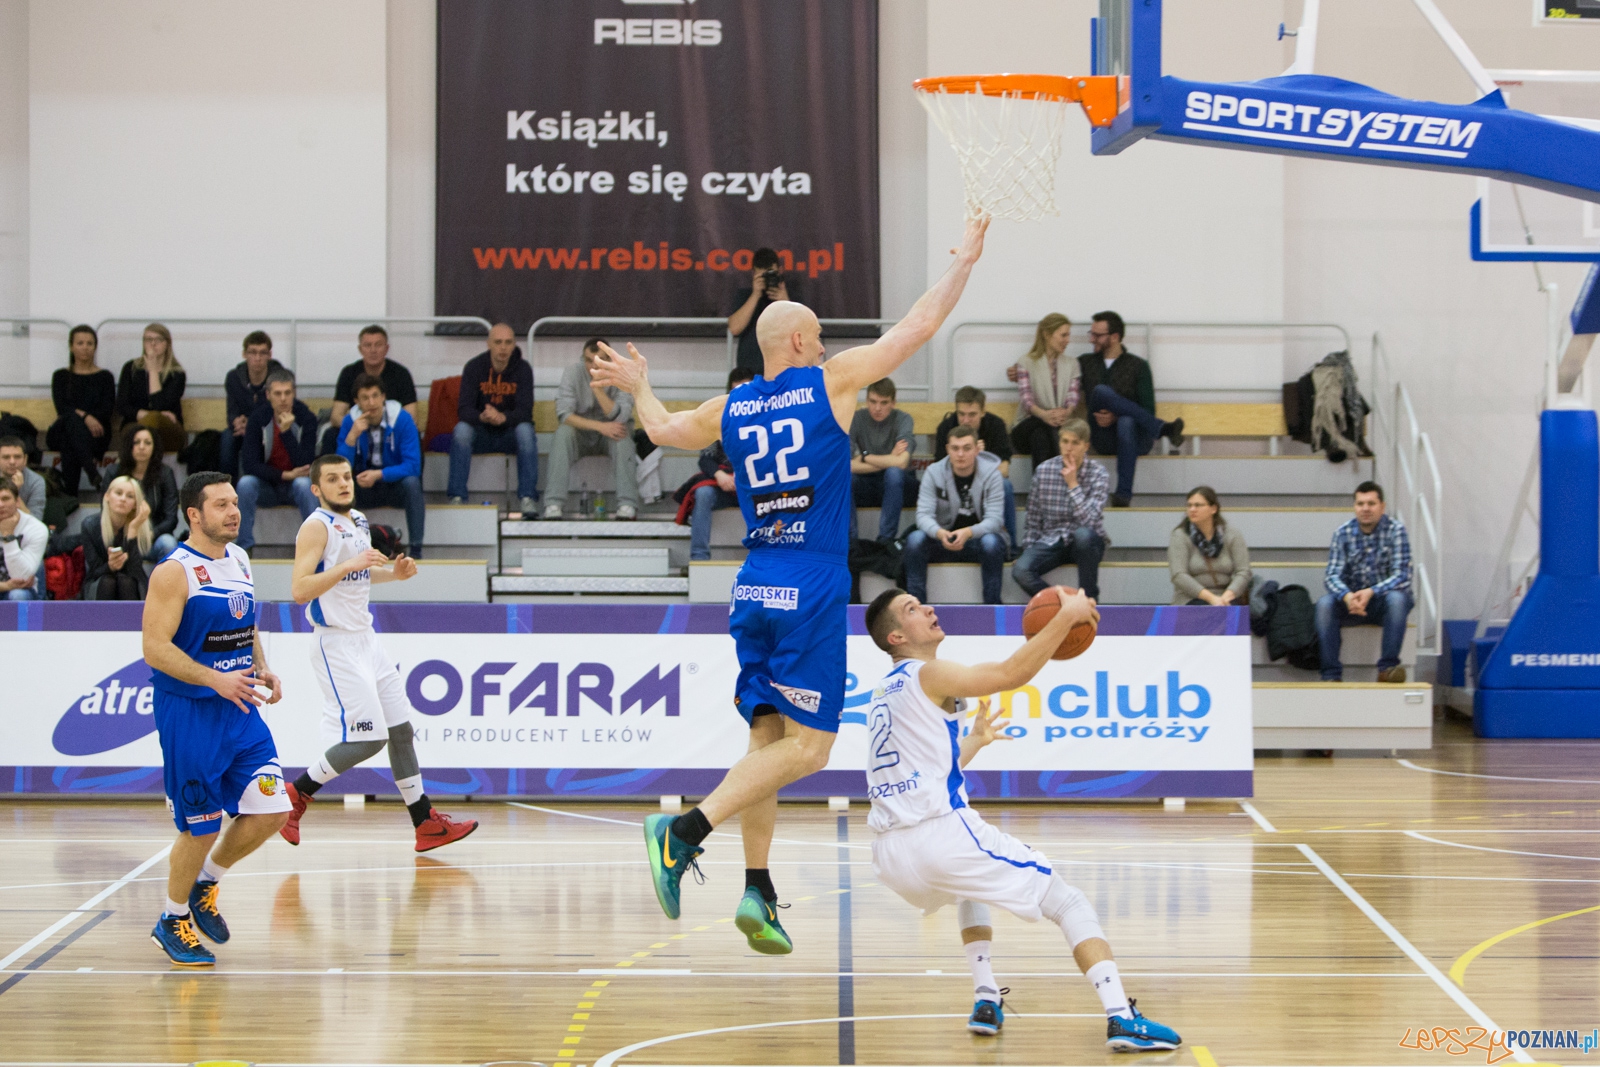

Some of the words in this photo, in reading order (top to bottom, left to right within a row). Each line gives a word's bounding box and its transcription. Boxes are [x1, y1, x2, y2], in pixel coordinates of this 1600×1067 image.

[594, 18, 722, 45] REBIS
[507, 110, 668, 149] Książki,
[506, 163, 614, 194] które
[628, 165, 688, 202] się
[701, 166, 812, 202] czyta
[738, 417, 810, 488] 22
[736, 586, 797, 601] OPOLSKIE
[395, 659, 680, 717] OFARM
[356, 721, 373, 732] PBG
[443, 728, 568, 742] PRODUCENT
[582, 725, 652, 742] LEKÓW
[1044, 721, 1210, 743] podróży
